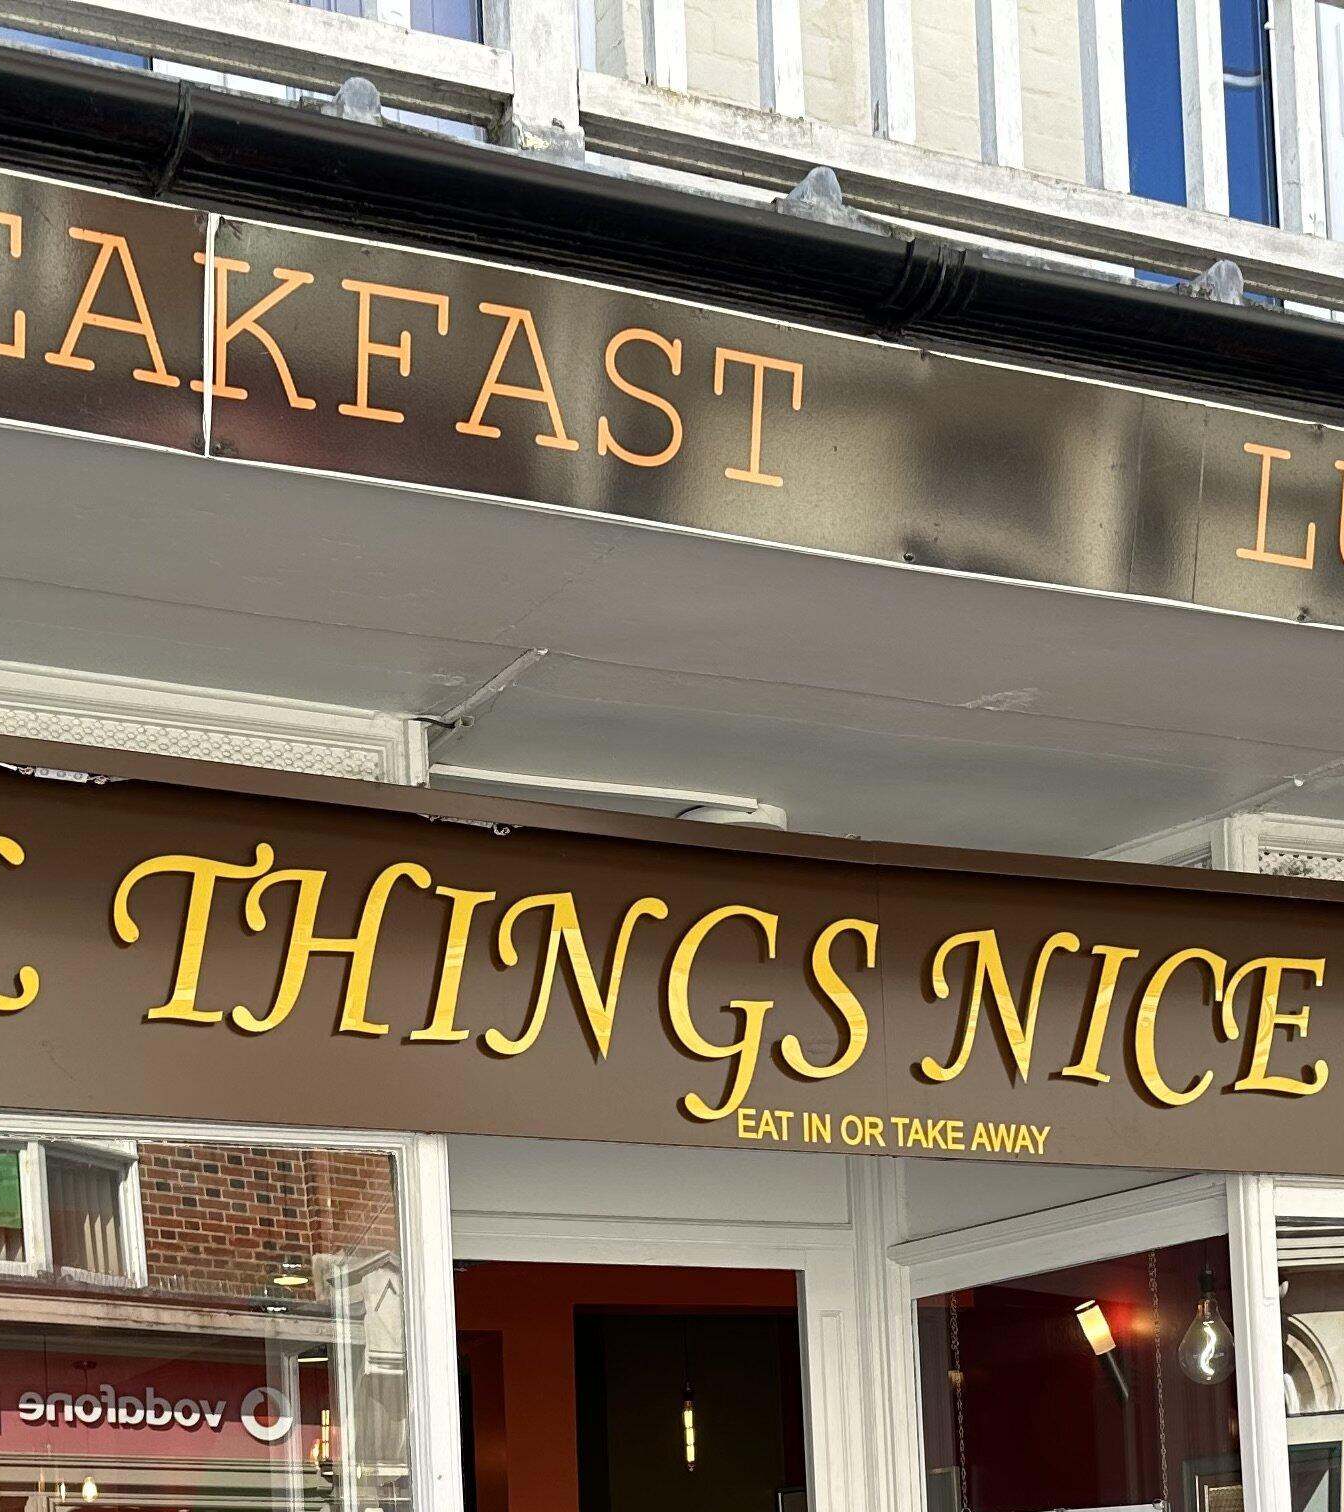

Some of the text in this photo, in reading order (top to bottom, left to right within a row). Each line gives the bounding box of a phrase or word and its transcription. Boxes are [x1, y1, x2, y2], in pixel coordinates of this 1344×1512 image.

[112, 842, 879, 1121] THINGS
[920, 928, 1330, 1107] NICE
[737, 1107, 1051, 1155] EAT IN OR TAKE AWAY
